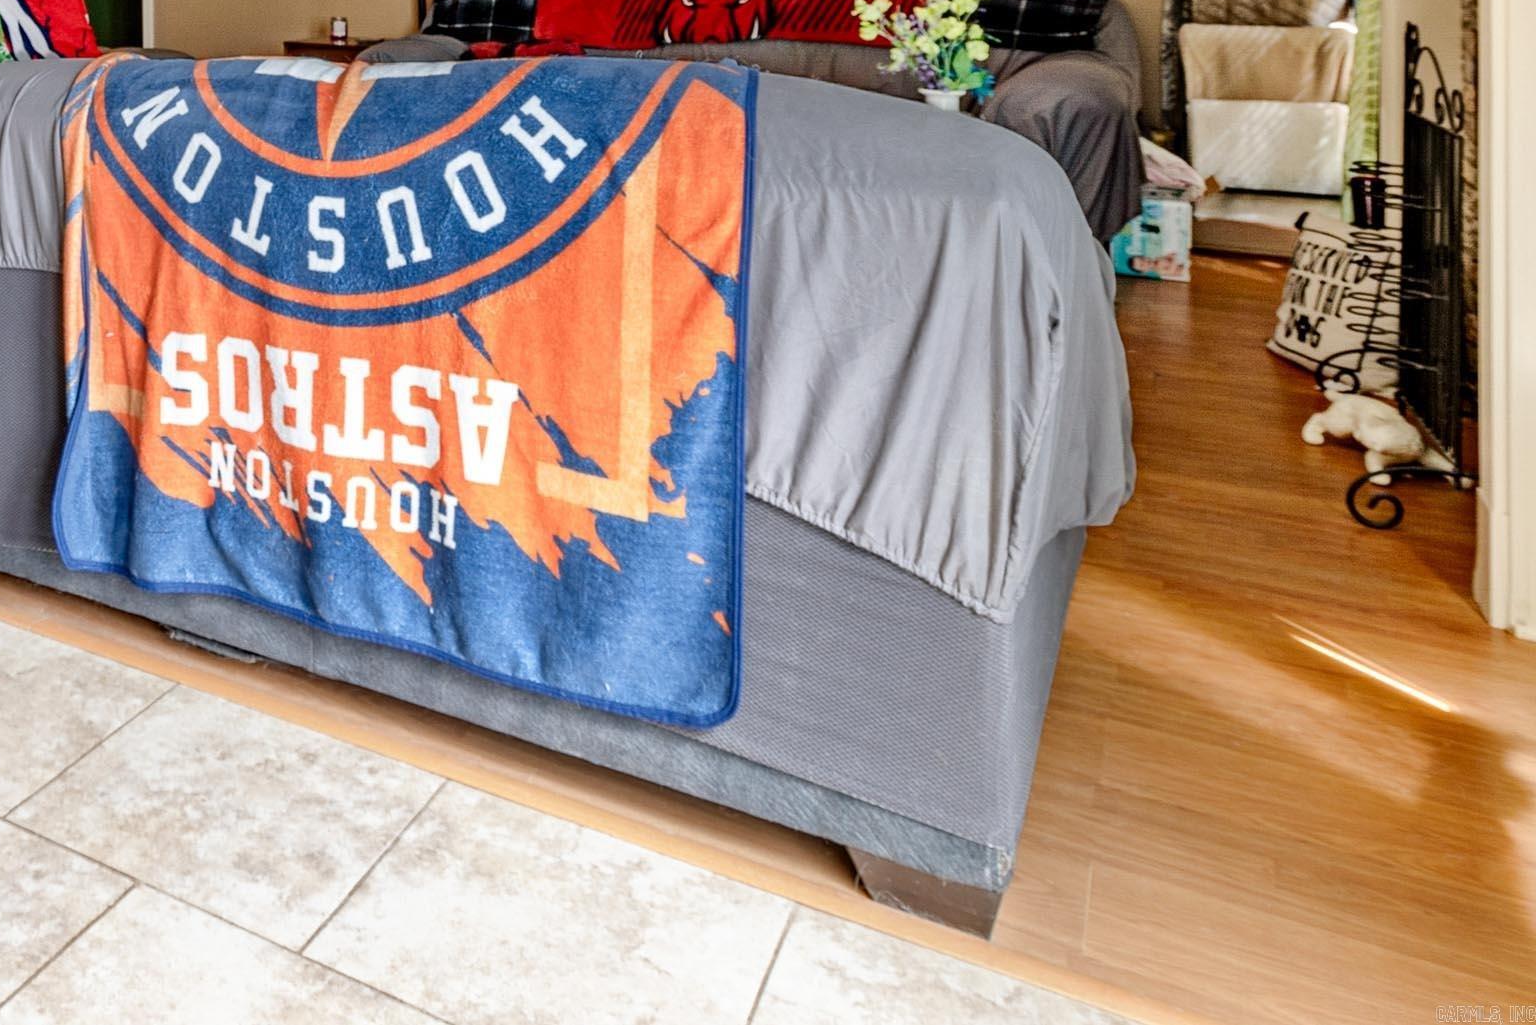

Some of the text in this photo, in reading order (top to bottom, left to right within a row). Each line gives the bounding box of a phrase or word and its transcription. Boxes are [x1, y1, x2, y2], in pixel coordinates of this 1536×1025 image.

[120, 85, 587, 274] HOUSTON
[158, 331, 520, 487] ASTROS
[207, 441, 459, 550] HOUSTON
